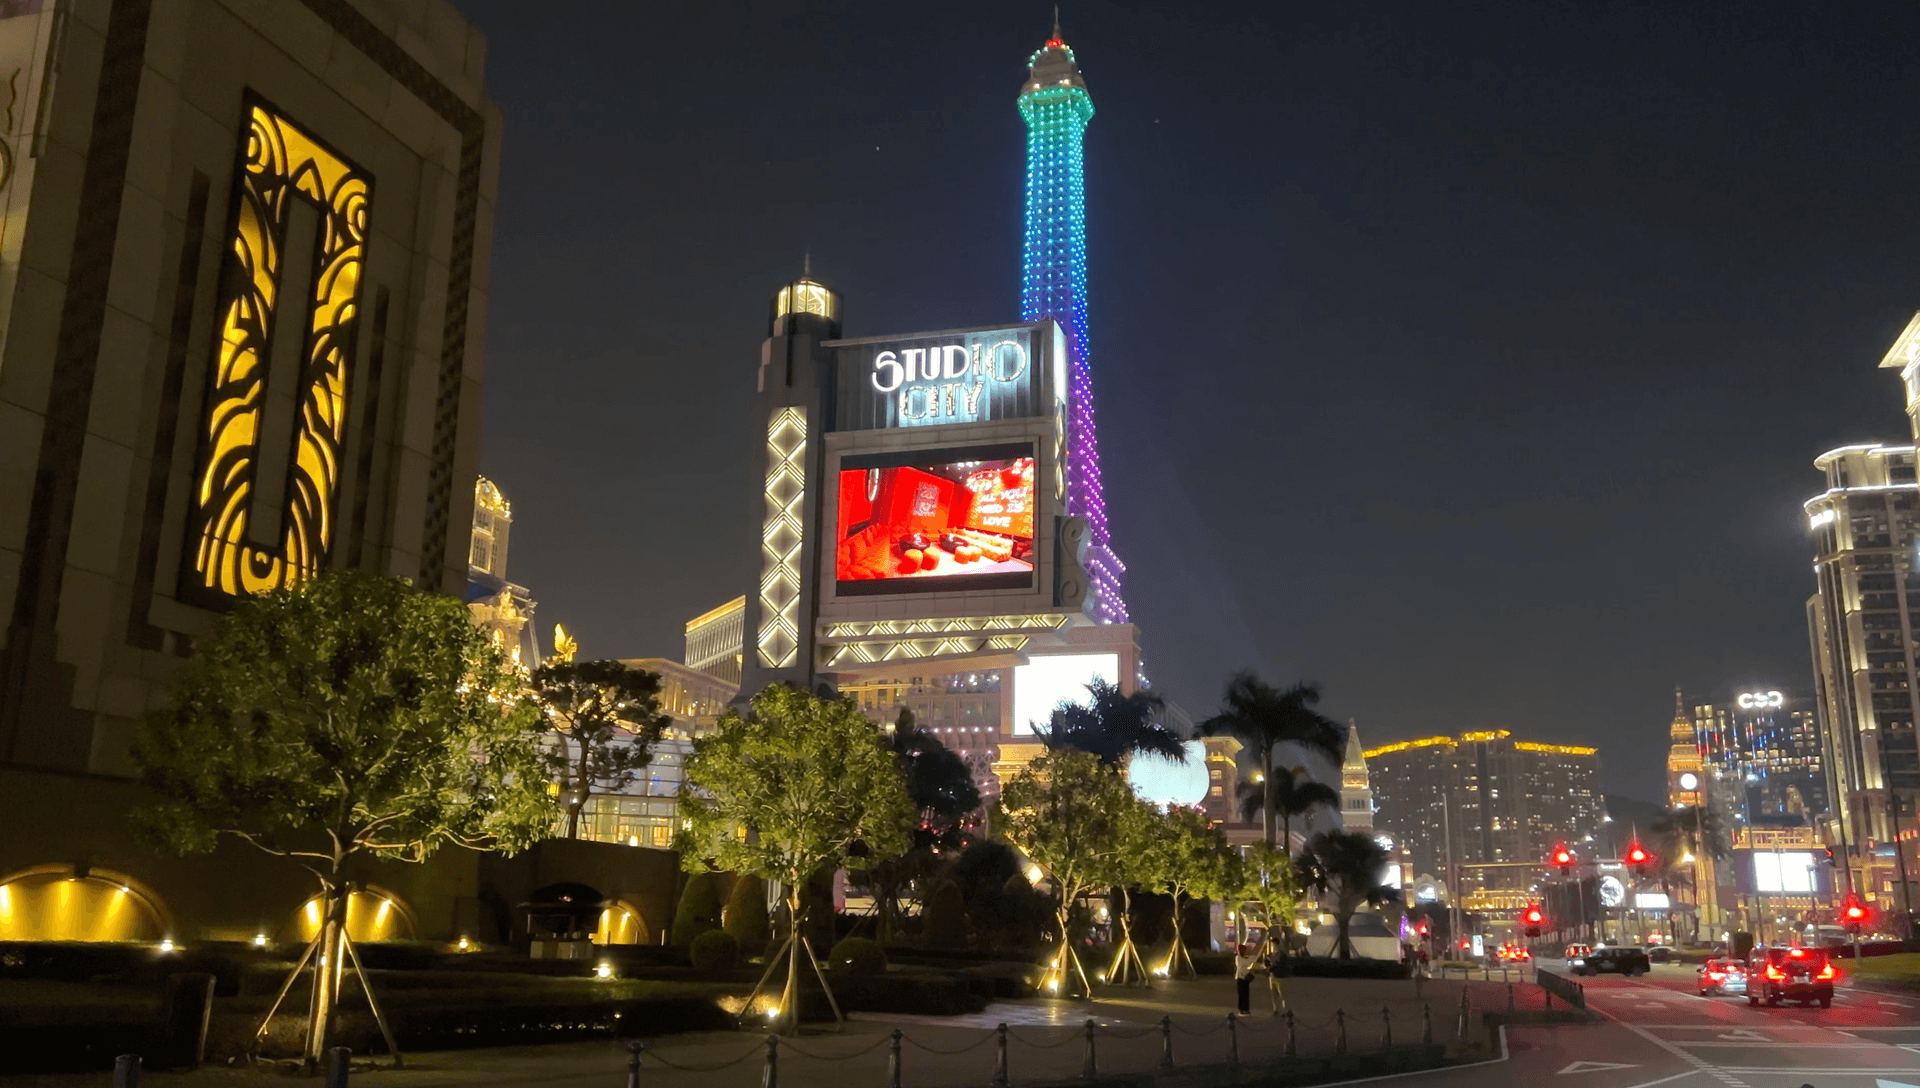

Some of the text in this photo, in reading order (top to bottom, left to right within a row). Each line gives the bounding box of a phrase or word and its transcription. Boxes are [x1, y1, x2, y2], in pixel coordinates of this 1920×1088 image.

[872, 340, 1027, 392] STUDIO
[899, 381, 984, 419] CITY
[983, 516, 1011, 528] LOVE
